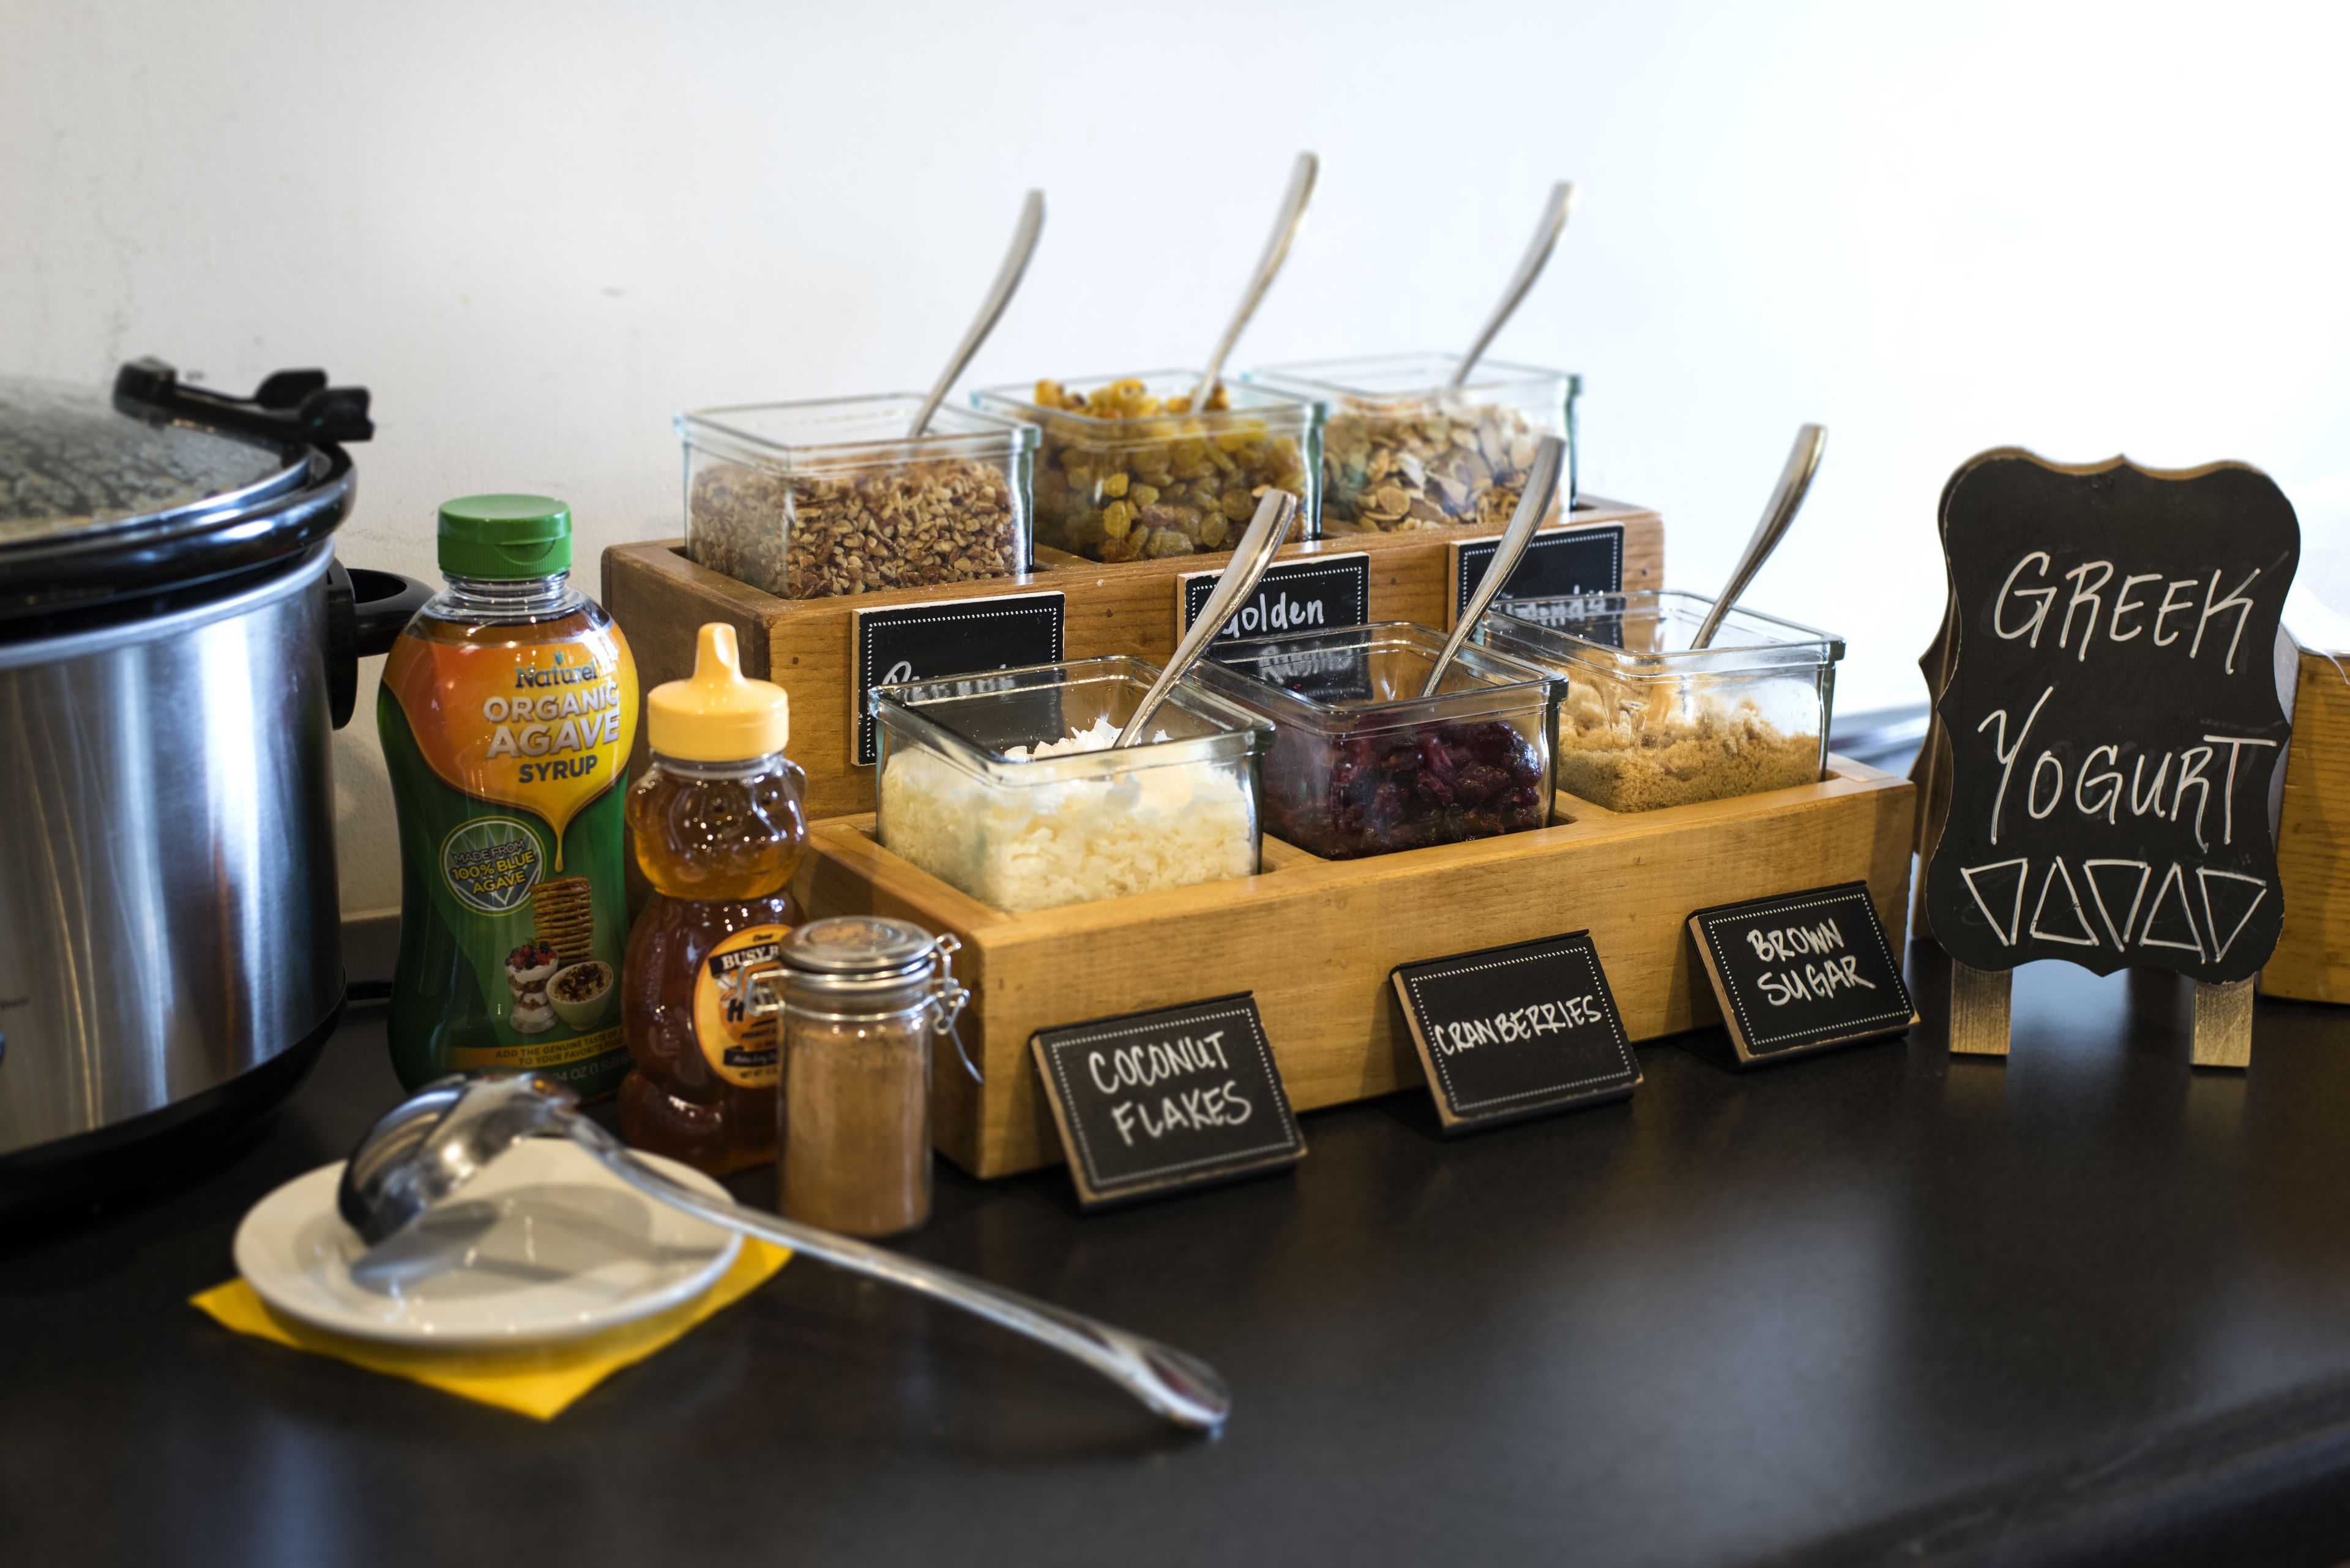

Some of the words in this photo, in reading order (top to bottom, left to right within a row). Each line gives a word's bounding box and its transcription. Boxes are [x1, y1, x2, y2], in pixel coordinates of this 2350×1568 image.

[1994, 550, 2261, 674] GREEK
[516, 660, 598, 688] Naturel
[483, 681, 619, 723] ORGANIC
[486, 707, 620, 759] AGAVE
[519, 755, 598, 783] SYRUP
[1978, 686, 2277, 852] YOGURT
[452, 863, 495, 880] 100%
[496, 850, 535, 872] BLUE
[454, 849, 490, 864] MADE
[491, 840, 525, 857] FROM
[472, 870, 526, 894] AGAVE
[722, 946, 766, 970] BUSY
[1747, 917, 1845, 962] BROWN
[1757, 955, 1877, 1007] SUGAR
[496, 1049, 518, 1058] ADD
[521, 1047, 540, 1056] THE
[543, 1040, 582, 1055] GENUINE
[583, 1033, 606, 1045] TASTE
[1433, 994, 1602, 1056] CRANBERRIES
[518, 1057, 532, 1066] TO
[535, 1053, 562, 1064] YOUR
[564, 1043, 603, 1059] FAVORITE
[1088, 1030, 1229, 1094] COCONUT
[1111, 1079, 1252, 1146] FLAKES
